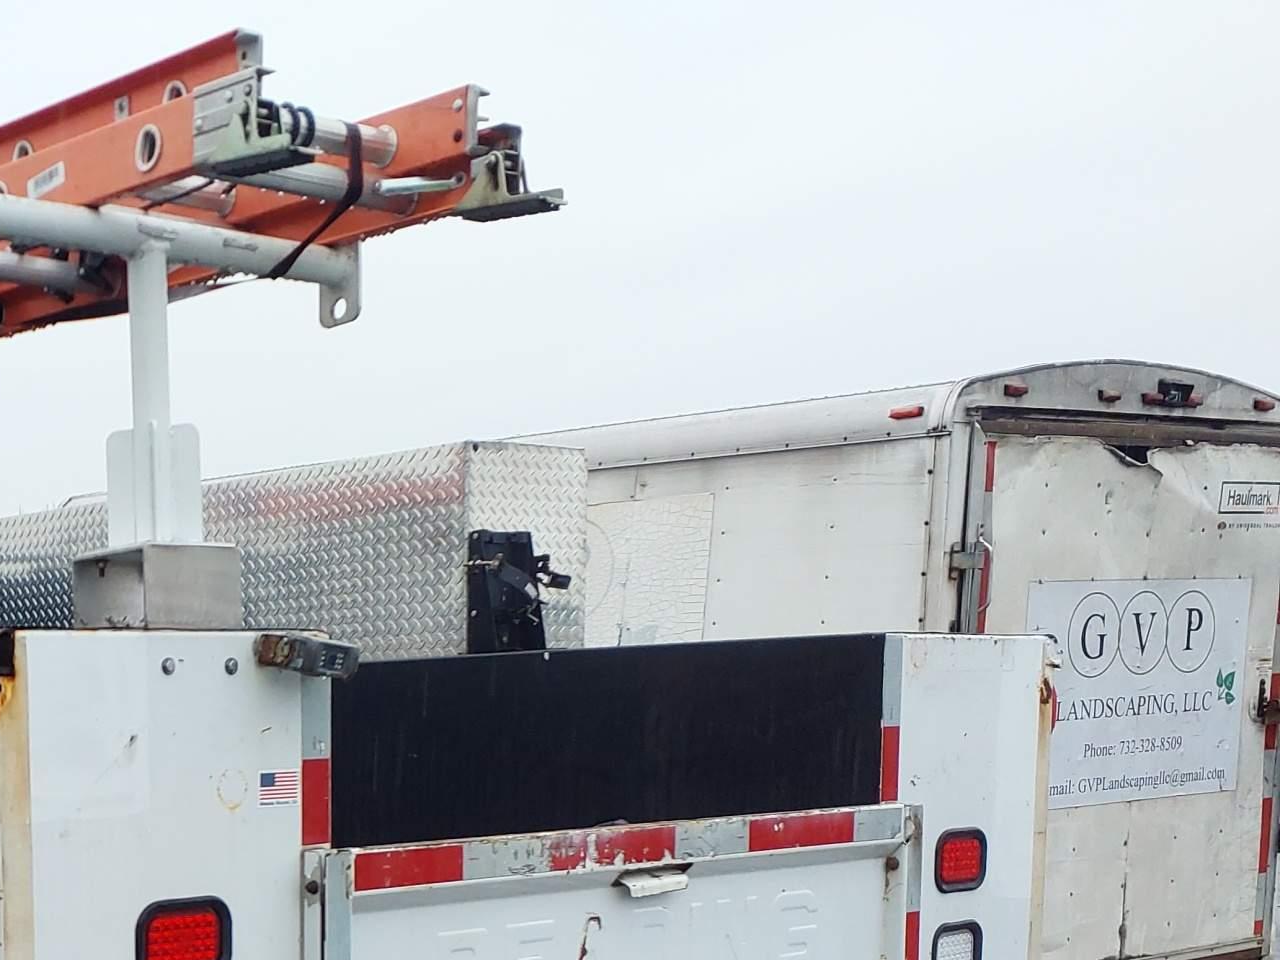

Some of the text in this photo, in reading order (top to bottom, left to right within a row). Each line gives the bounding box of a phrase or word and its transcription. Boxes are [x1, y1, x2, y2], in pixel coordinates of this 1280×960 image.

[1227, 488, 1272, 506] Haulmark
[1056, 691, 1213, 722] LANDSCAPING, LLC
[1083, 736, 1183, 758] Phone: 732-328-8509
[1048, 768, 1225, 796] mail: GVPLandscapingllc@gmail.com
